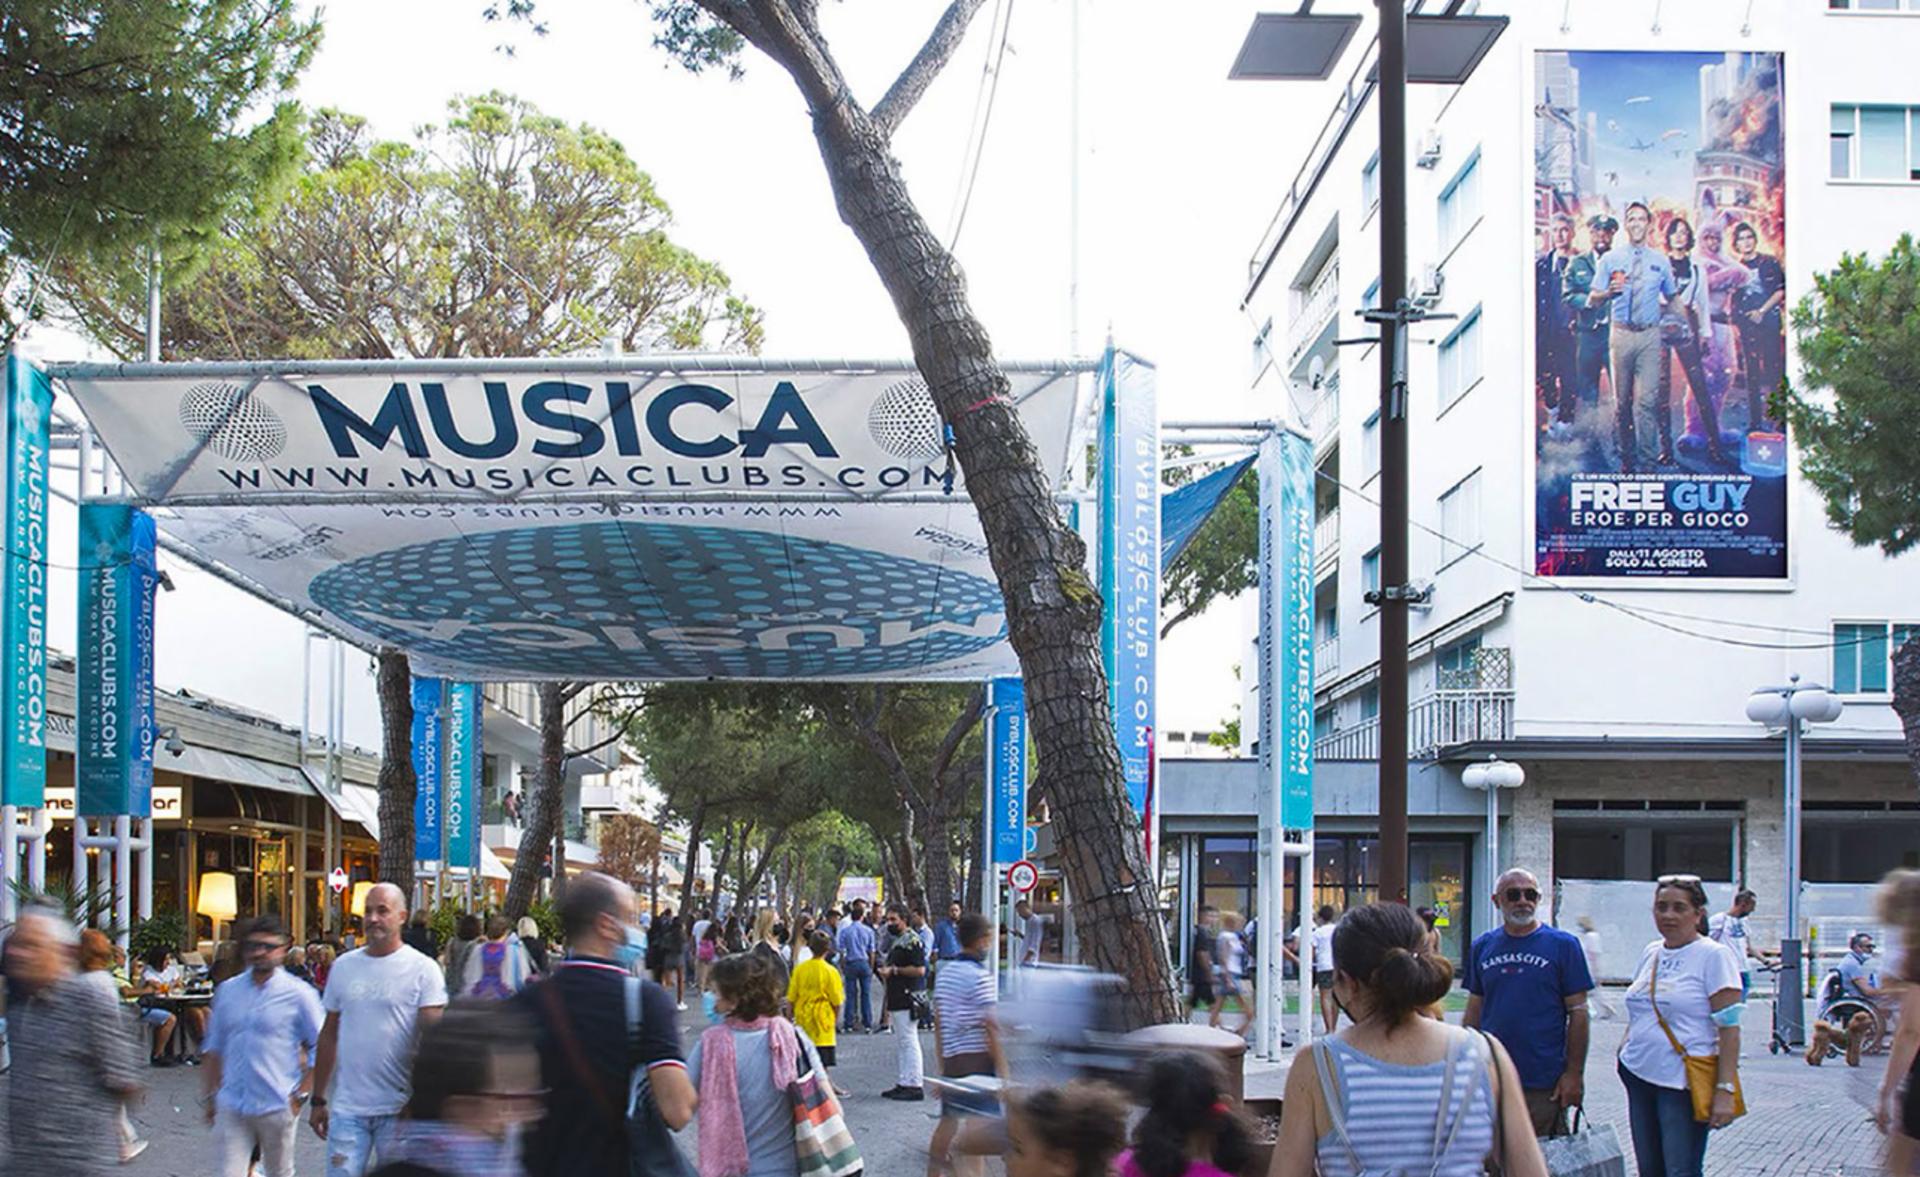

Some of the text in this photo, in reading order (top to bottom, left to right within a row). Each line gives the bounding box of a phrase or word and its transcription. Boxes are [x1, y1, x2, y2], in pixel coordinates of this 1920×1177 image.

[306, 381, 839, 460] MUSICA
[1571, 482, 1751, 511] FREE GUY
[1571, 512, 1749, 527] EROE PER GIOCO
[18, 498, 26, 551] YORK
[1605, 558, 1708, 568] SOLO AL CINEMA
[1652, 549, 1704, 558] AGOSTO
[18, 563, 26, 610] CITY
[28, 445, 43, 746] MUSICACLUBS.COM
[1135, 440, 1149, 747] BYBLOSCLUB.COM
[352, 609, 1004, 652] MUSICA
[1298, 509, 1311, 776] MUSICACLUBS.COM
[101, 567, 117, 758] MUSICACLUBS.COM
[451, 691, 463, 838] MUSICACLUBS.COM
[1008, 716, 1019, 829] BYBLOSCLUB.COM
[1481, 952, 1549, 969] KANSAS CITY
